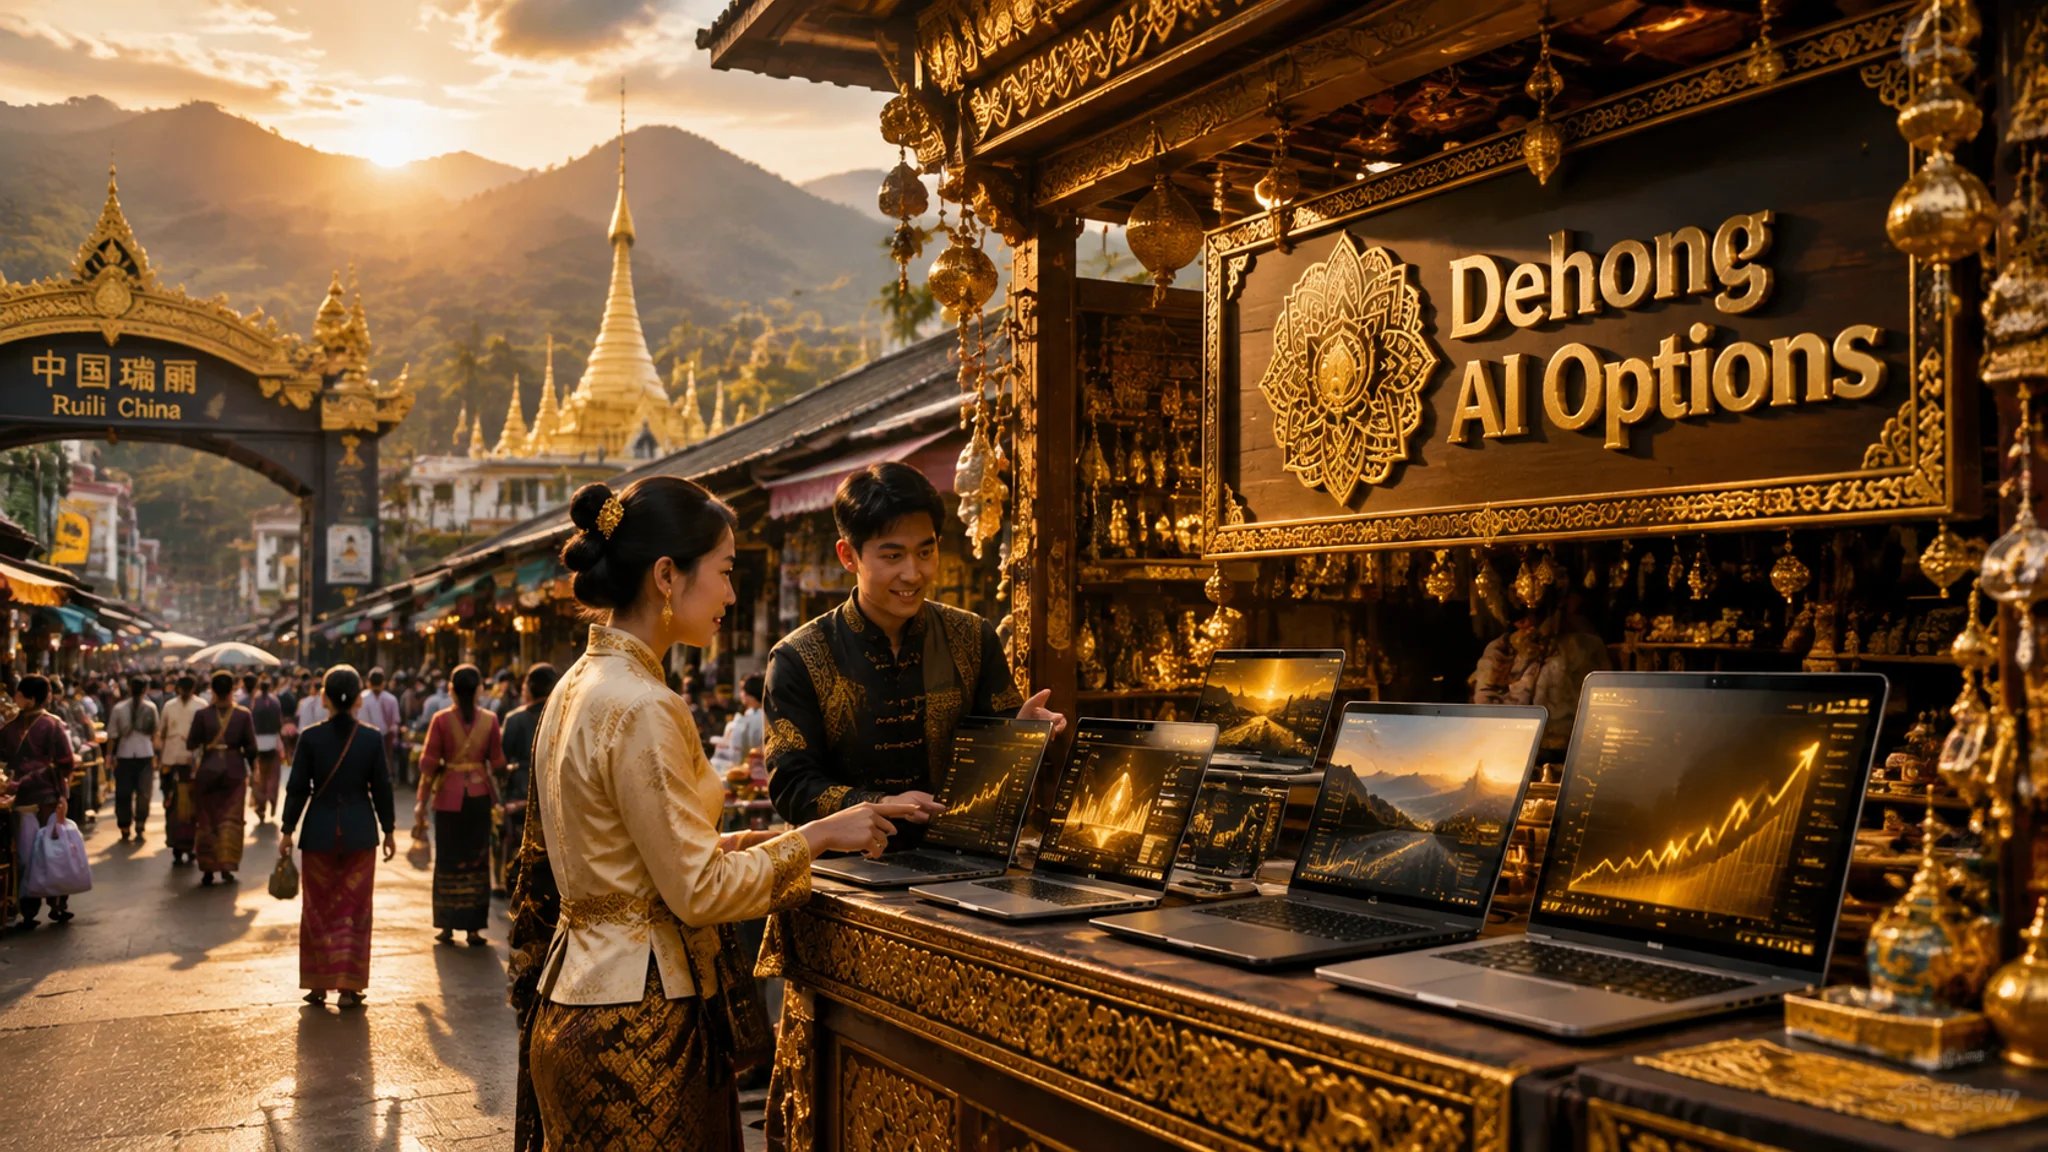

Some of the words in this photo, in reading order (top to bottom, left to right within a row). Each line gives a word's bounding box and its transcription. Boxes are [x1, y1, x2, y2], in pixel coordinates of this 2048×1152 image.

[1449, 209, 1774, 340] Dehong
[32, 349, 198, 394] 中国瑞丽
[52, 394, 107, 416] Ruili
[118, 397, 181, 420] China
[1447, 353, 1529, 444] AI
[1543, 322, 1888, 450] Options
